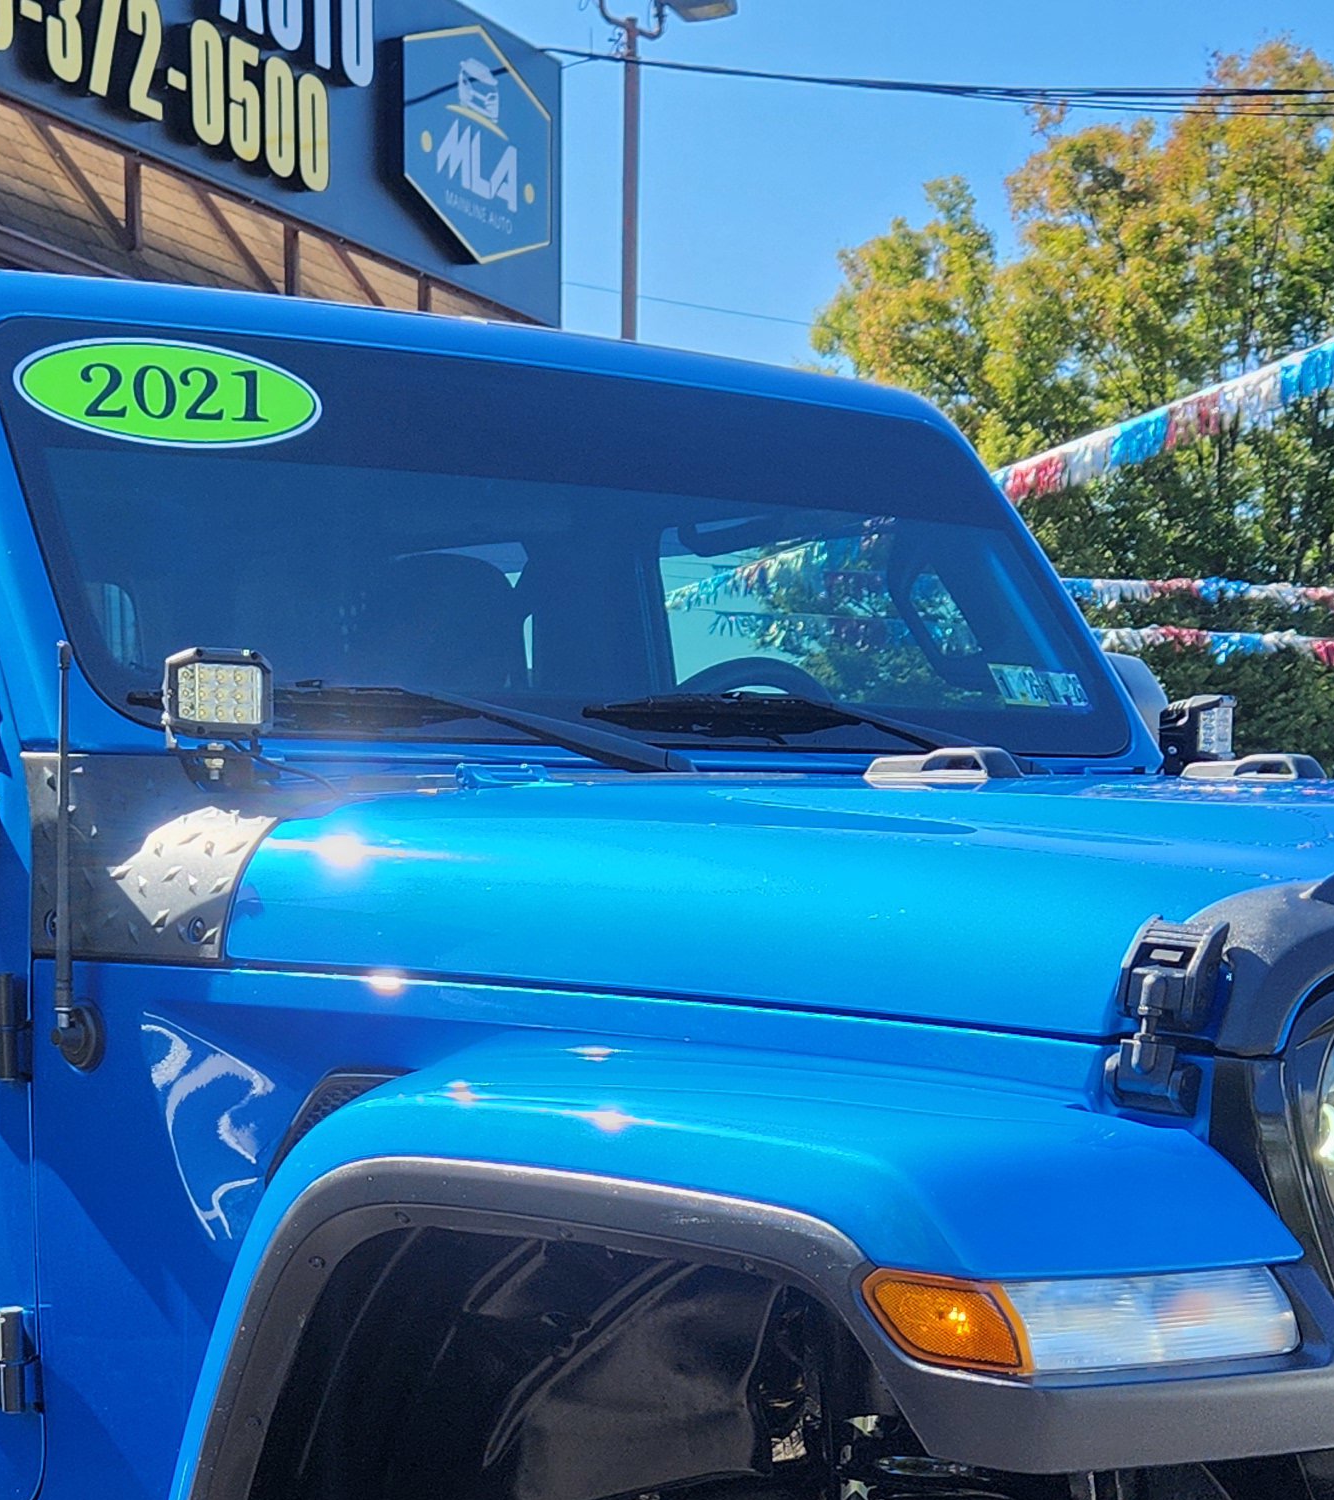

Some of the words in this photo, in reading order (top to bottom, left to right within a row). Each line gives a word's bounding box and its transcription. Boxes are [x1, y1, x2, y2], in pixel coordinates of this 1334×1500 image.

[436, 118, 517, 213] MLA
[488, 211, 514, 236] AUTO
[80, 362, 269, 423] 2021
